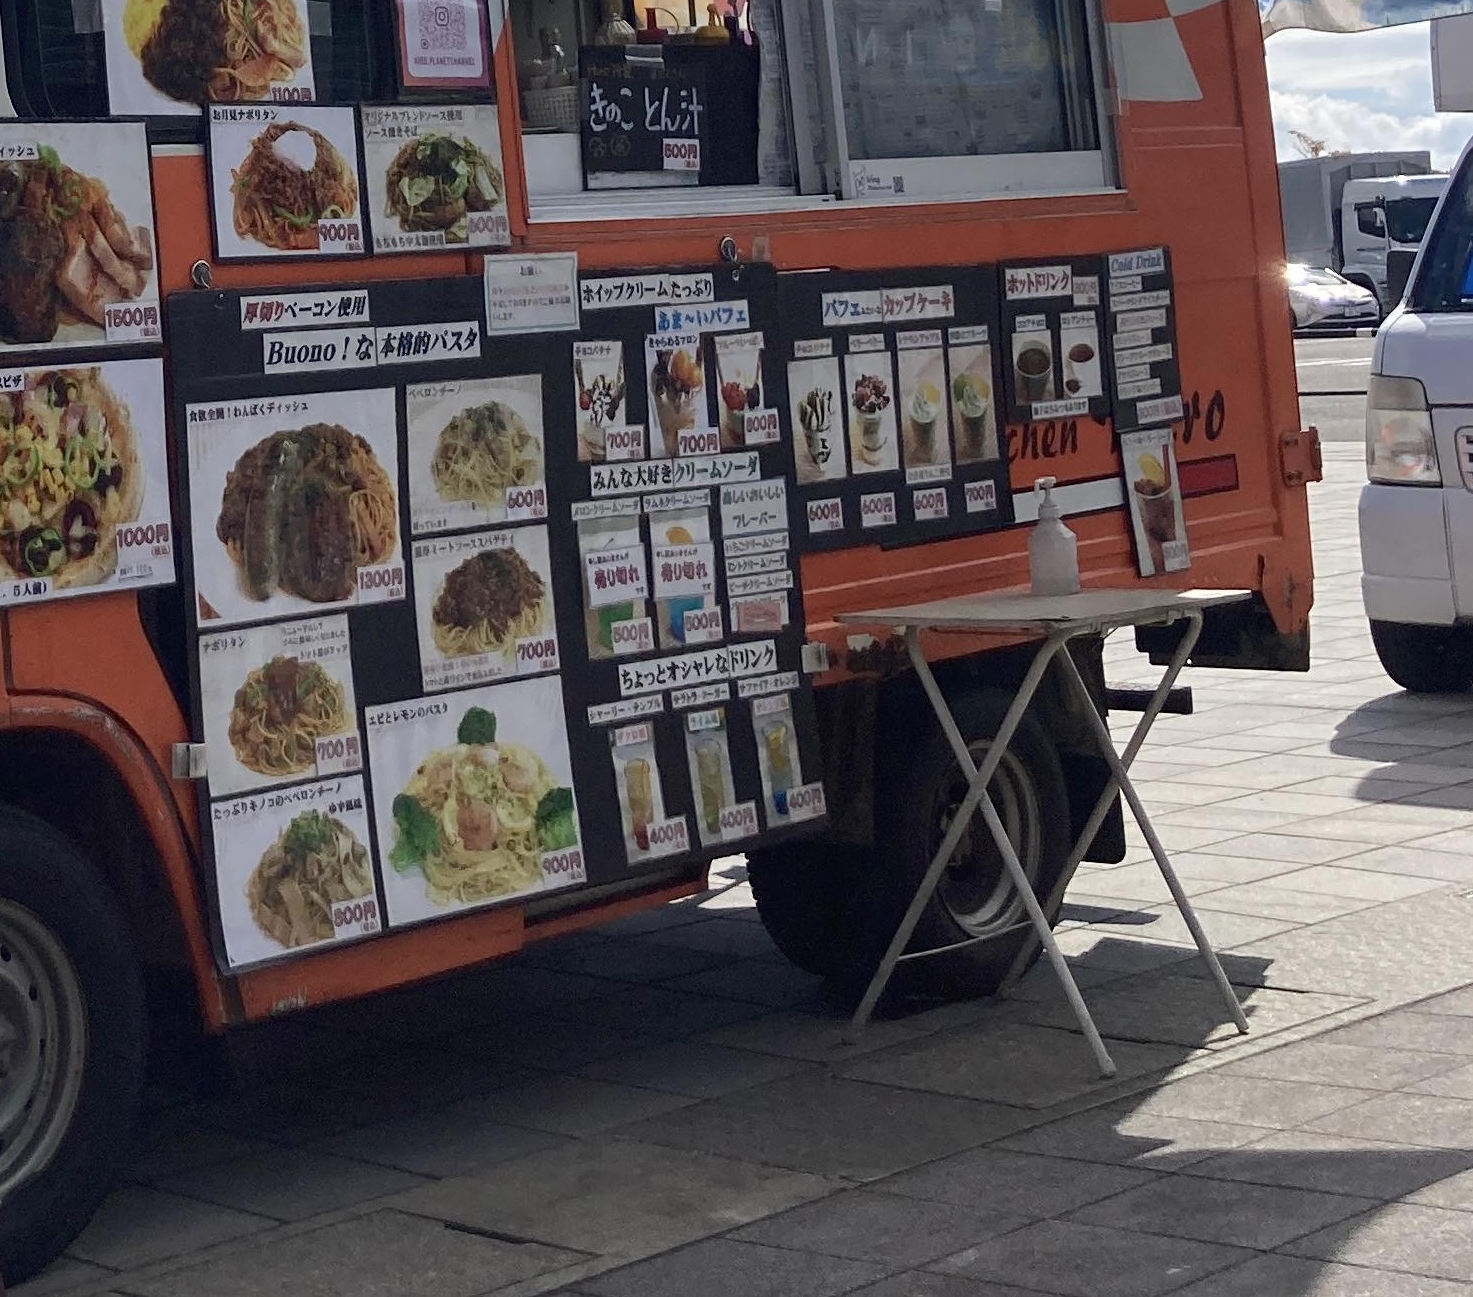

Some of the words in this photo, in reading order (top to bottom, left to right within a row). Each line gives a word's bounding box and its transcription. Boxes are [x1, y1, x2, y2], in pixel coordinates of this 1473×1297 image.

[212, 108, 278, 121] お月見ナポリタン
[590, 82, 634, 132] きのこ
[644, 86, 703, 135] とん汁
[319, 223, 360, 242] 900円
[1111, 257, 1133, 272] Cold
[1136, 252, 1163, 270] Drink
[582, 277, 713, 303] ホイップクリームたっぷり
[1007, 270, 1070, 295] ホットドリンク
[243, 296, 367, 323] 厚切りベーコン使用
[606, 432, 642, 450] 700円
[679, 432, 719, 454] 700円
[593, 456, 758, 490] みんな大好きクリームソーダ
[732, 512, 777, 529] フレーバー
[807, 504, 840, 522] 600円
[116, 523, 170, 548] 1000円
[359, 567, 403, 590] 1300円
[594, 564, 640, 590] 売り切れ
[661, 559, 708, 583] 売り切れ
[202, 636, 246, 653] ナポリタン
[517, 638, 556, 661] 700円
[621, 645, 775, 690] ちょっとオシャレなドリンク
[369, 702, 448, 726] エビとレモンのパスタ
[317, 737, 359, 760] 700円
[214, 782, 343, 820] たっぷりキノコのペペロンチーノ
[542, 851, 582, 875] 900円
